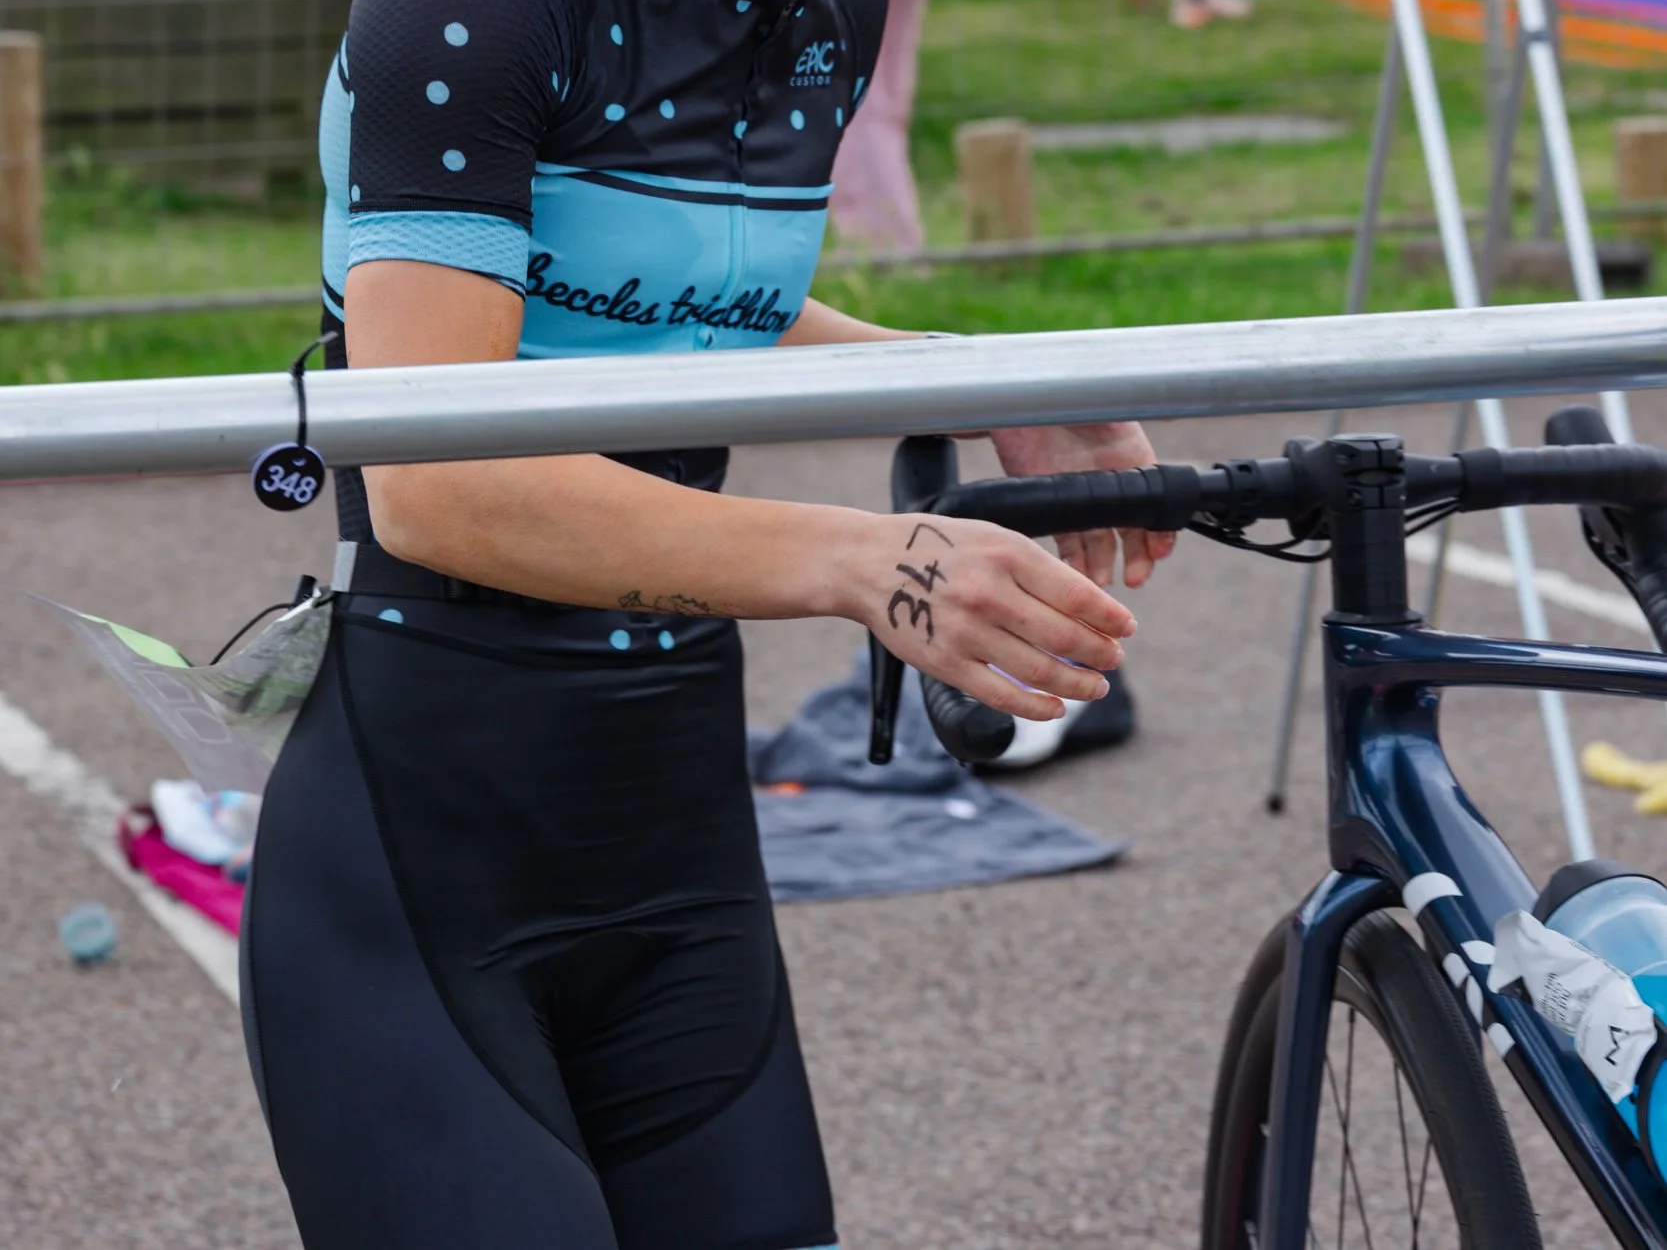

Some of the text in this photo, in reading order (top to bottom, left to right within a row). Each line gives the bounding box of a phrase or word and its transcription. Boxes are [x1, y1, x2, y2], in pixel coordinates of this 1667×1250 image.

[526, 252, 800, 333] beccles triathlon
[262, 465, 317, 503] 348
[887, 523, 955, 645] 347
